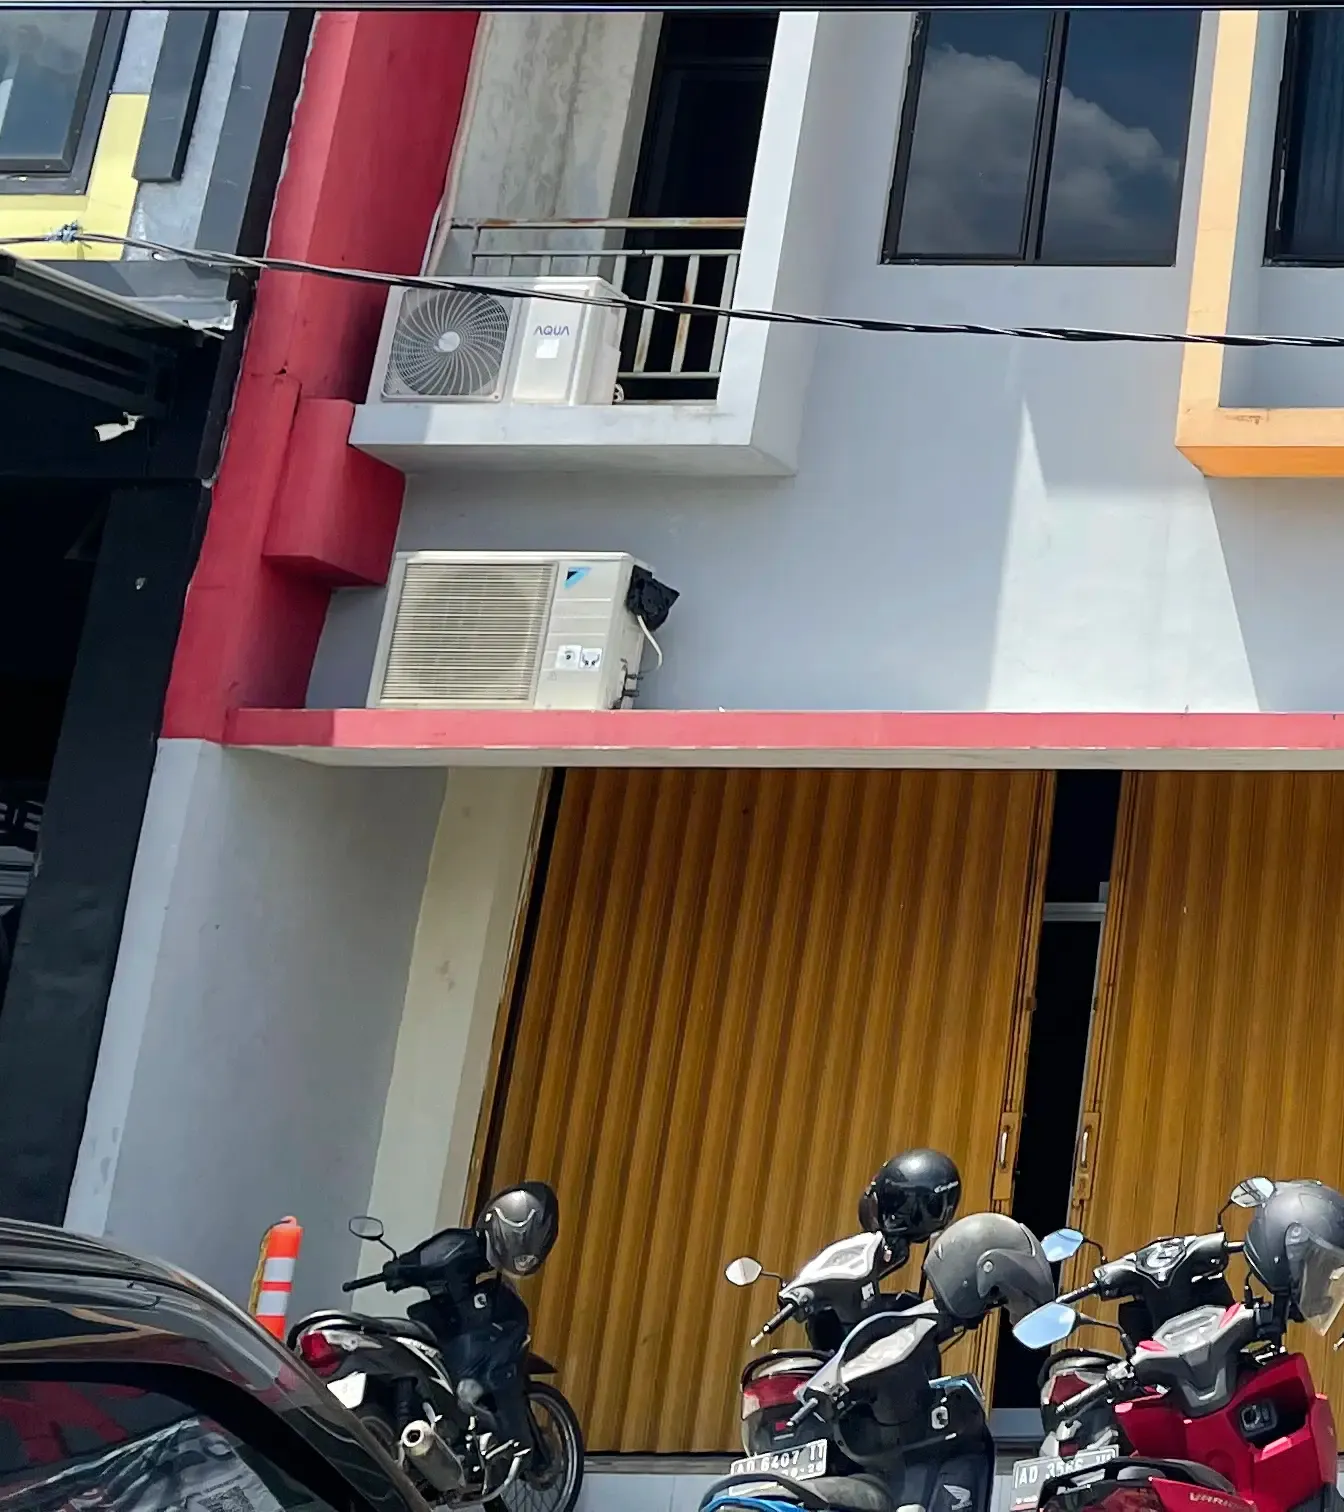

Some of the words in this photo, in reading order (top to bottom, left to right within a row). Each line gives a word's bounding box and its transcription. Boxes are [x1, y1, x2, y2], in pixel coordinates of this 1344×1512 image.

[533, 325, 570, 336] AQUA
[760, 1451, 801, 1472] 6407
[1019, 1465, 1039, 1485] AD
